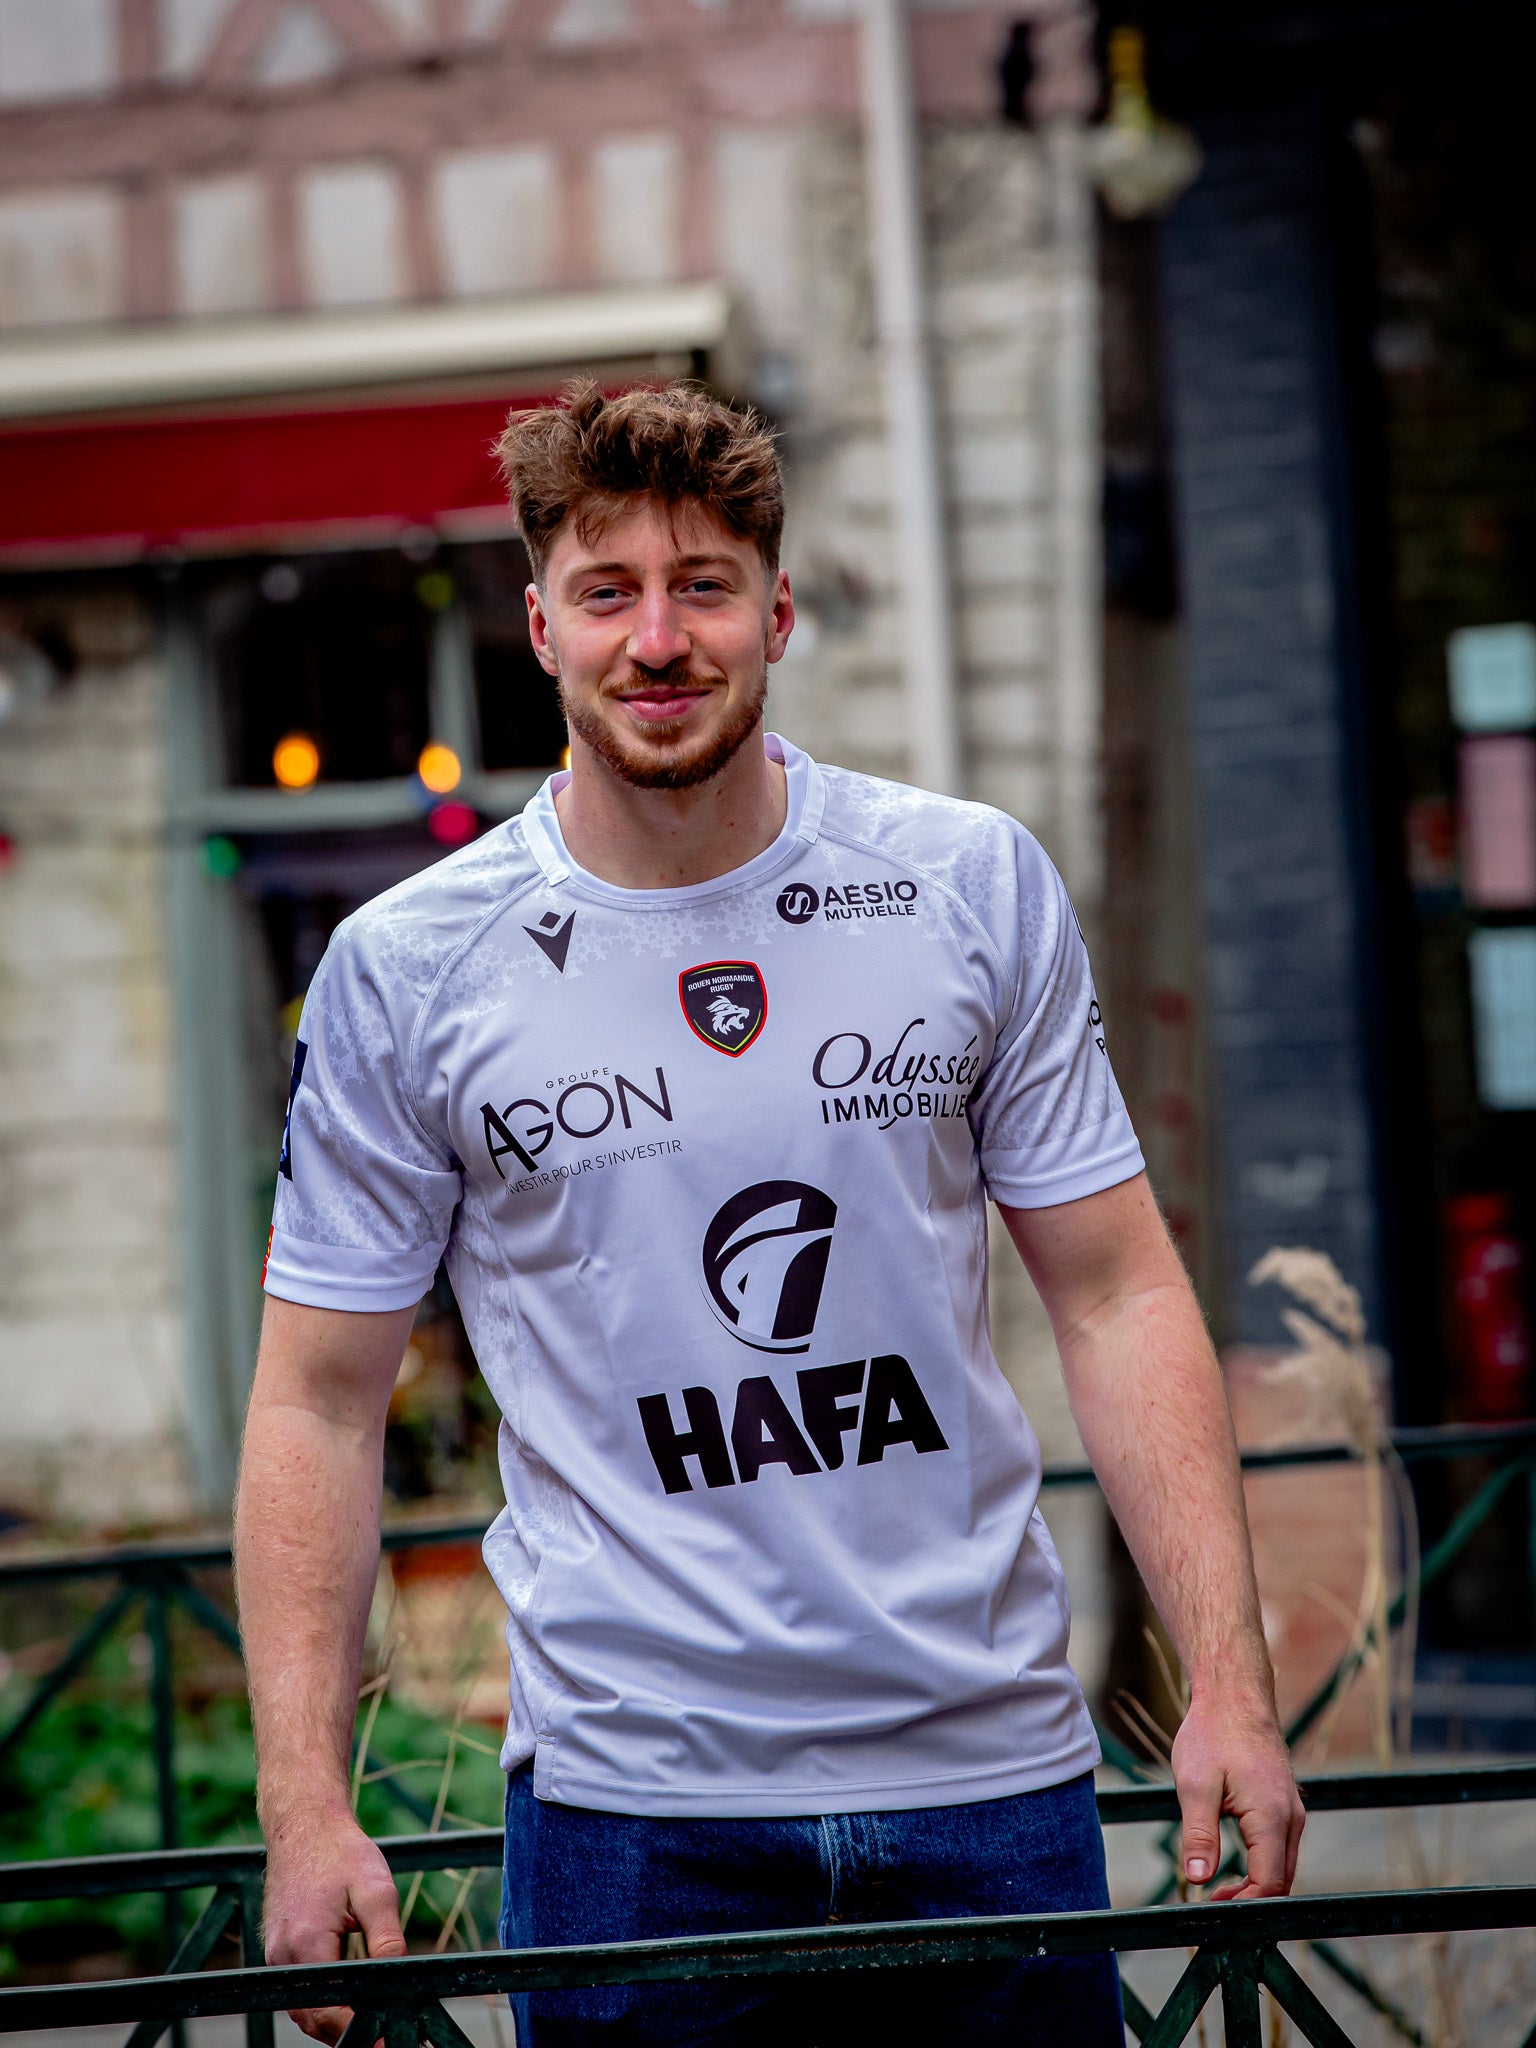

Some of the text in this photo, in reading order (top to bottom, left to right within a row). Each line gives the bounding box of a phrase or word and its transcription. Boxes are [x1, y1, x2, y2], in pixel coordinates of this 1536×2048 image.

[825, 881, 918, 907] AÉSIO
[826, 904, 916, 921] MUTUELLE
[687, 974, 755, 992] ROUEN NORMANDIE
[710, 983, 734, 993] RUGBY
[545, 1067, 610, 1089] GROUPE
[812, 1018, 980, 1130] Odyssée
[820, 1091, 970, 1125] IMMOBILIE
[479, 1067, 673, 1180] AGON
[552, 1159, 594, 1181] POUR
[595, 1139, 683, 1168] S'INVESTIR
[636, 1354, 950, 1495] HAFA
